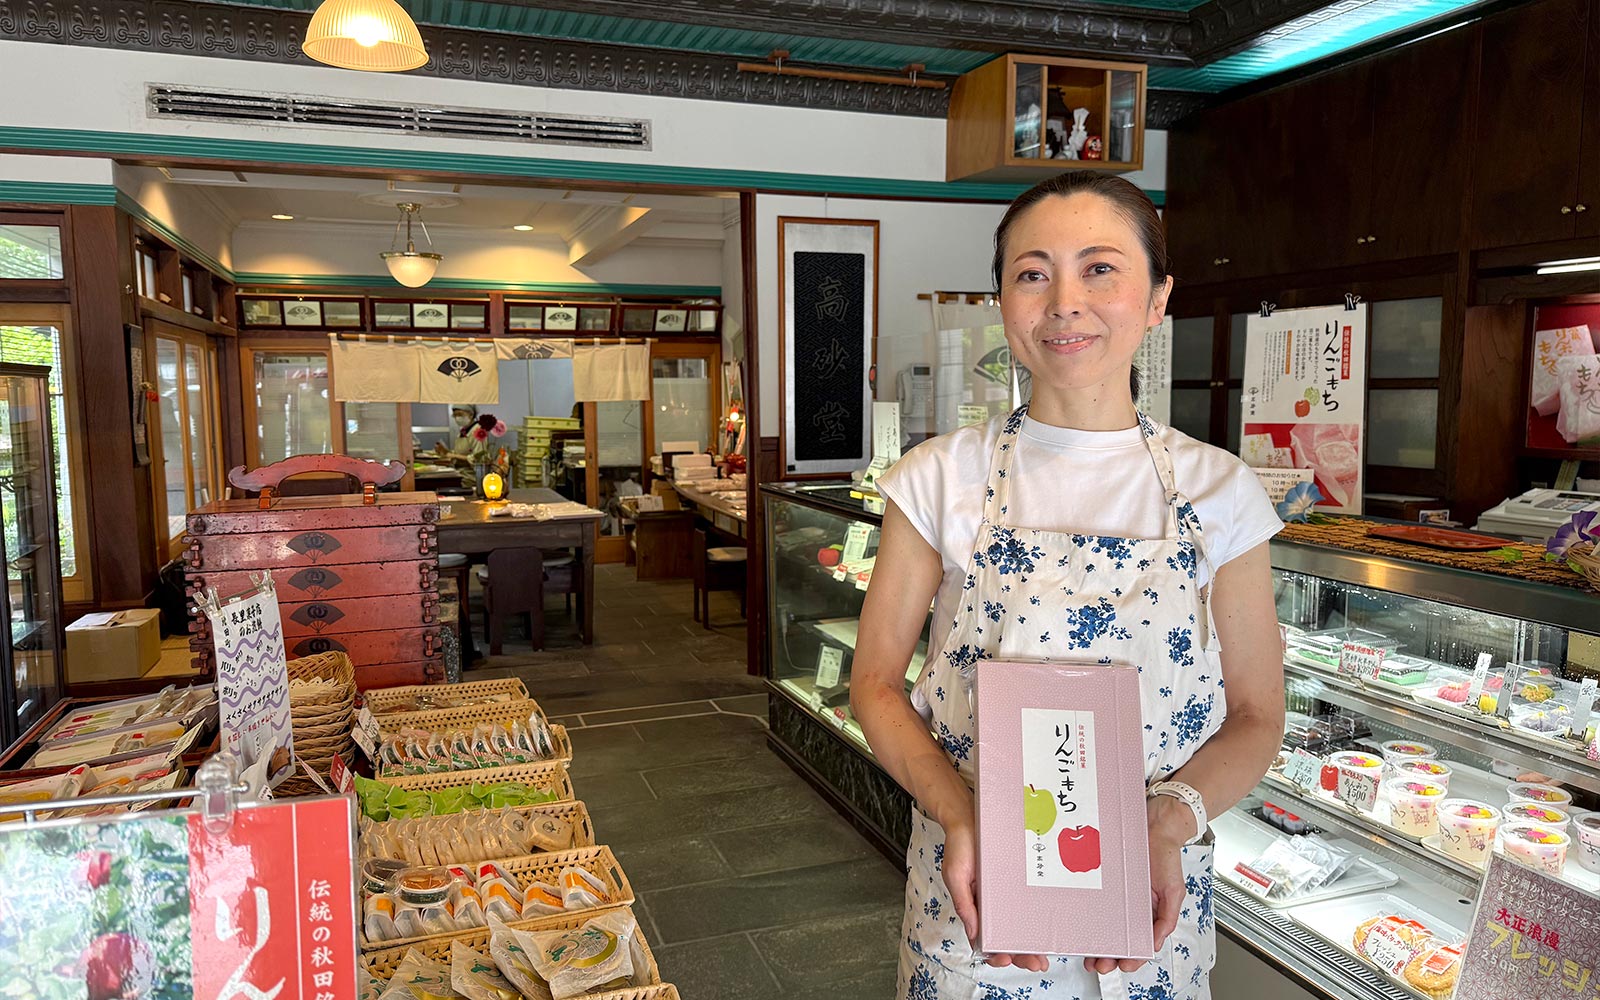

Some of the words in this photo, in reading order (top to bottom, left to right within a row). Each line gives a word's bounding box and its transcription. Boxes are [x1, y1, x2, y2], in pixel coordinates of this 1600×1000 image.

[813, 276, 849, 443] 高砂堂
[1321, 320, 1340, 411] りんごもち
[1055, 723, 1077, 813] りんごもち
[1372, 948, 1395, 969] ¥250
[1495, 907, 1561, 951] 大正浪漫
